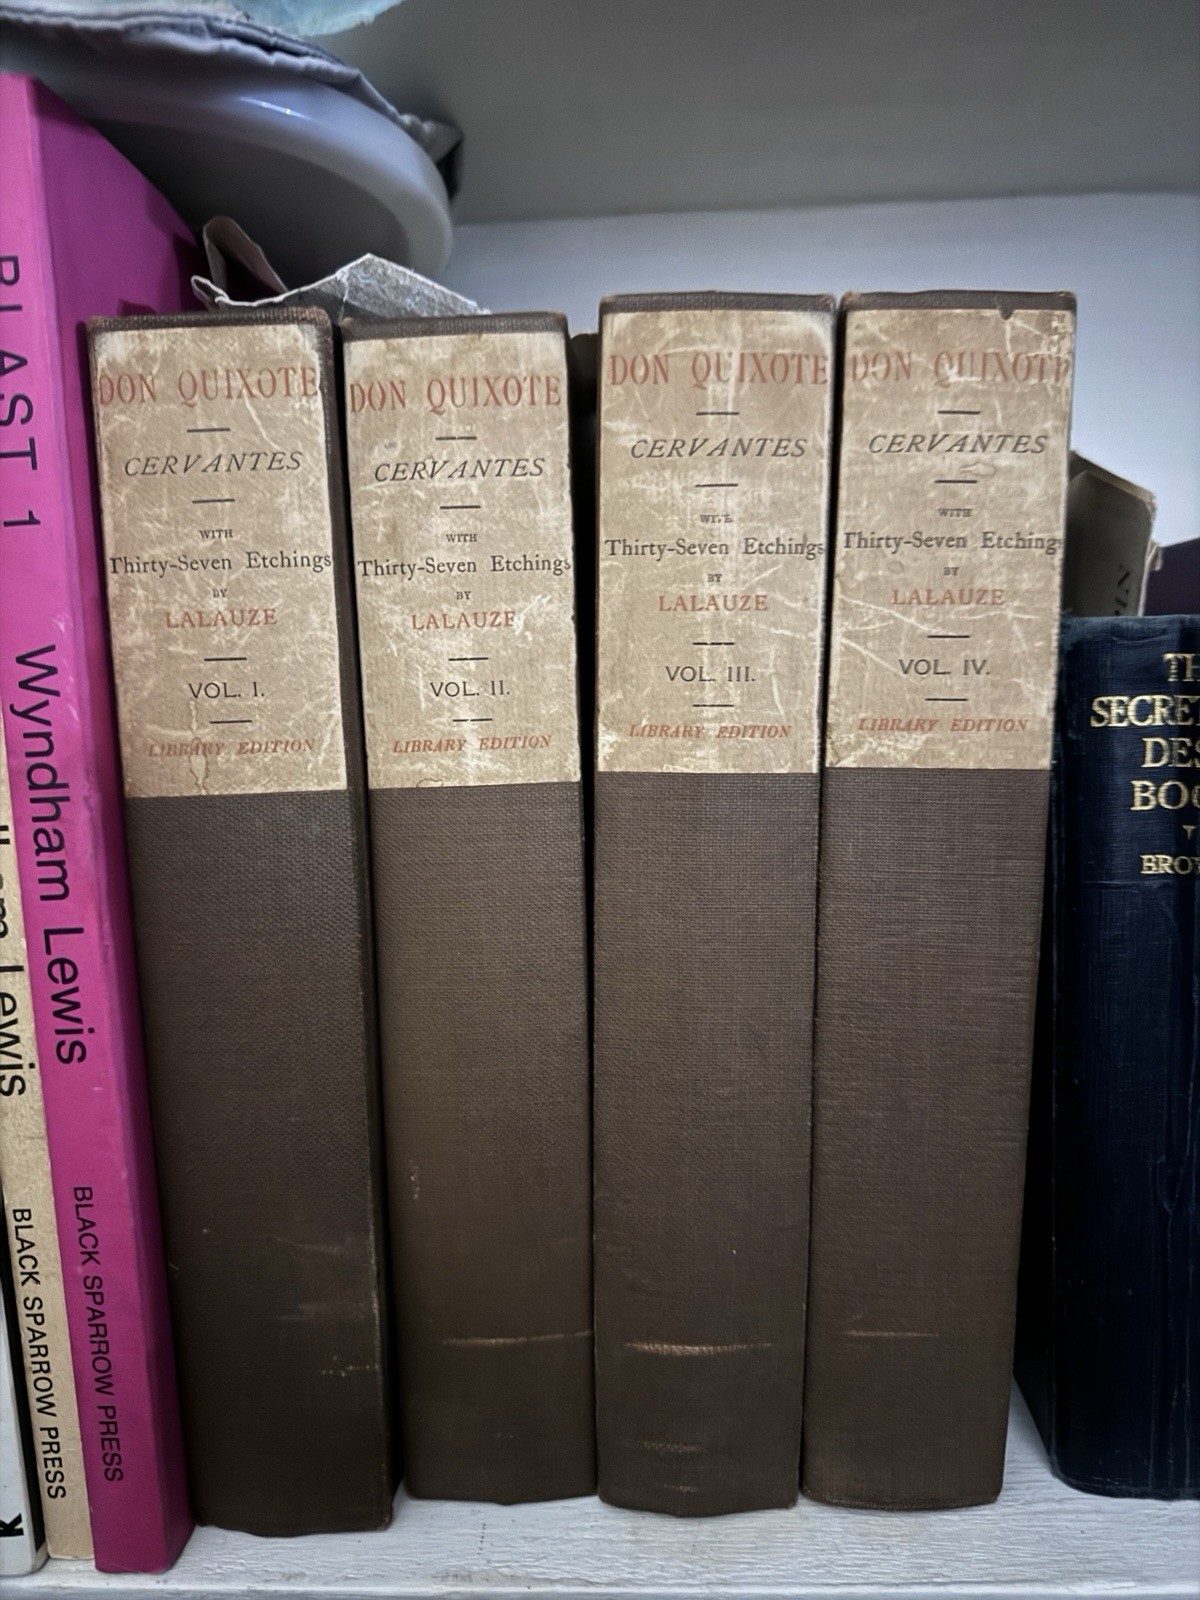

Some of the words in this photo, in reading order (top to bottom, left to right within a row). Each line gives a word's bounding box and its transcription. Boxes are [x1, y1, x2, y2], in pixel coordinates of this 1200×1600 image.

[609, 353, 669, 386] DON
[691, 352, 828, 390] QUIXOTE
[851, 351, 911, 382] DON
[100, 373, 157, 406] DON
[178, 367, 318, 409] QUIXOTE
[350, 380, 406, 413] DON
[426, 374, 562, 416] QUIXOTE
[631, 437, 808, 459] CERVANTES
[868, 433, 1048, 454] CERVANTES
[124, 451, 304, 476] CERVANTES
[374, 457, 546, 483] CERVANTES
[3, 510, 41, 527] 1
[938, 508, 972, 518] WITH
[199, 529, 233, 540] WITH
[445, 534, 477, 543] WITH
[843, 531, 968, 555] Thirty-Seven
[605, 538, 729, 561] Thirty-Seven
[743, 536, 824, 561] Etchings
[109, 554, 232, 578] Thirty-Seven
[246, 551, 332, 573] Etchings
[357, 557, 477, 581] Thirty-Seven
[490, 554, 571, 576] Etchings
[944, 567, 959, 576] BY
[707, 574, 723, 583] BY
[212, 589, 228, 598] BY
[456, 591, 472, 600] BY
[658, 595, 769, 612] LALAUZE
[892, 589, 1004, 606] LALAUZE
[165, 608, 278, 629] LALAUZE
[412, 611, 517, 630] LALAUZE
[727, 666, 756, 682] III.
[962, 659, 990, 675] IV.
[188, 682, 242, 699] VOL.
[253, 681, 265, 697] I.
[430, 681, 480, 697] VOL.
[491, 680, 510, 695] II.
[1090, 694, 1200, 727] SECRE
[629, 724, 702, 738] LIBRARY
[716, 725, 792, 739] EDITION
[857, 717, 938, 732] LIBRARY
[949, 717, 1029, 732] EDITION
[235, 738, 315, 756] EDITION
[392, 738, 467, 754] LIBRARY
[478, 735, 551, 751] EDITION
[10, 644, 71, 902] Wyndham
[43, 927, 95, 1065] Lewis
[73, 1186, 101, 1266] BLACK
[13, 1208, 41, 1287] BLACK
[83, 1275, 115, 1396] SPARROW
[24, 1297, 57, 1417] SPARROW
[97, 1405, 124, 1482] PRESS
[40, 1427, 66, 1499] PRESS
